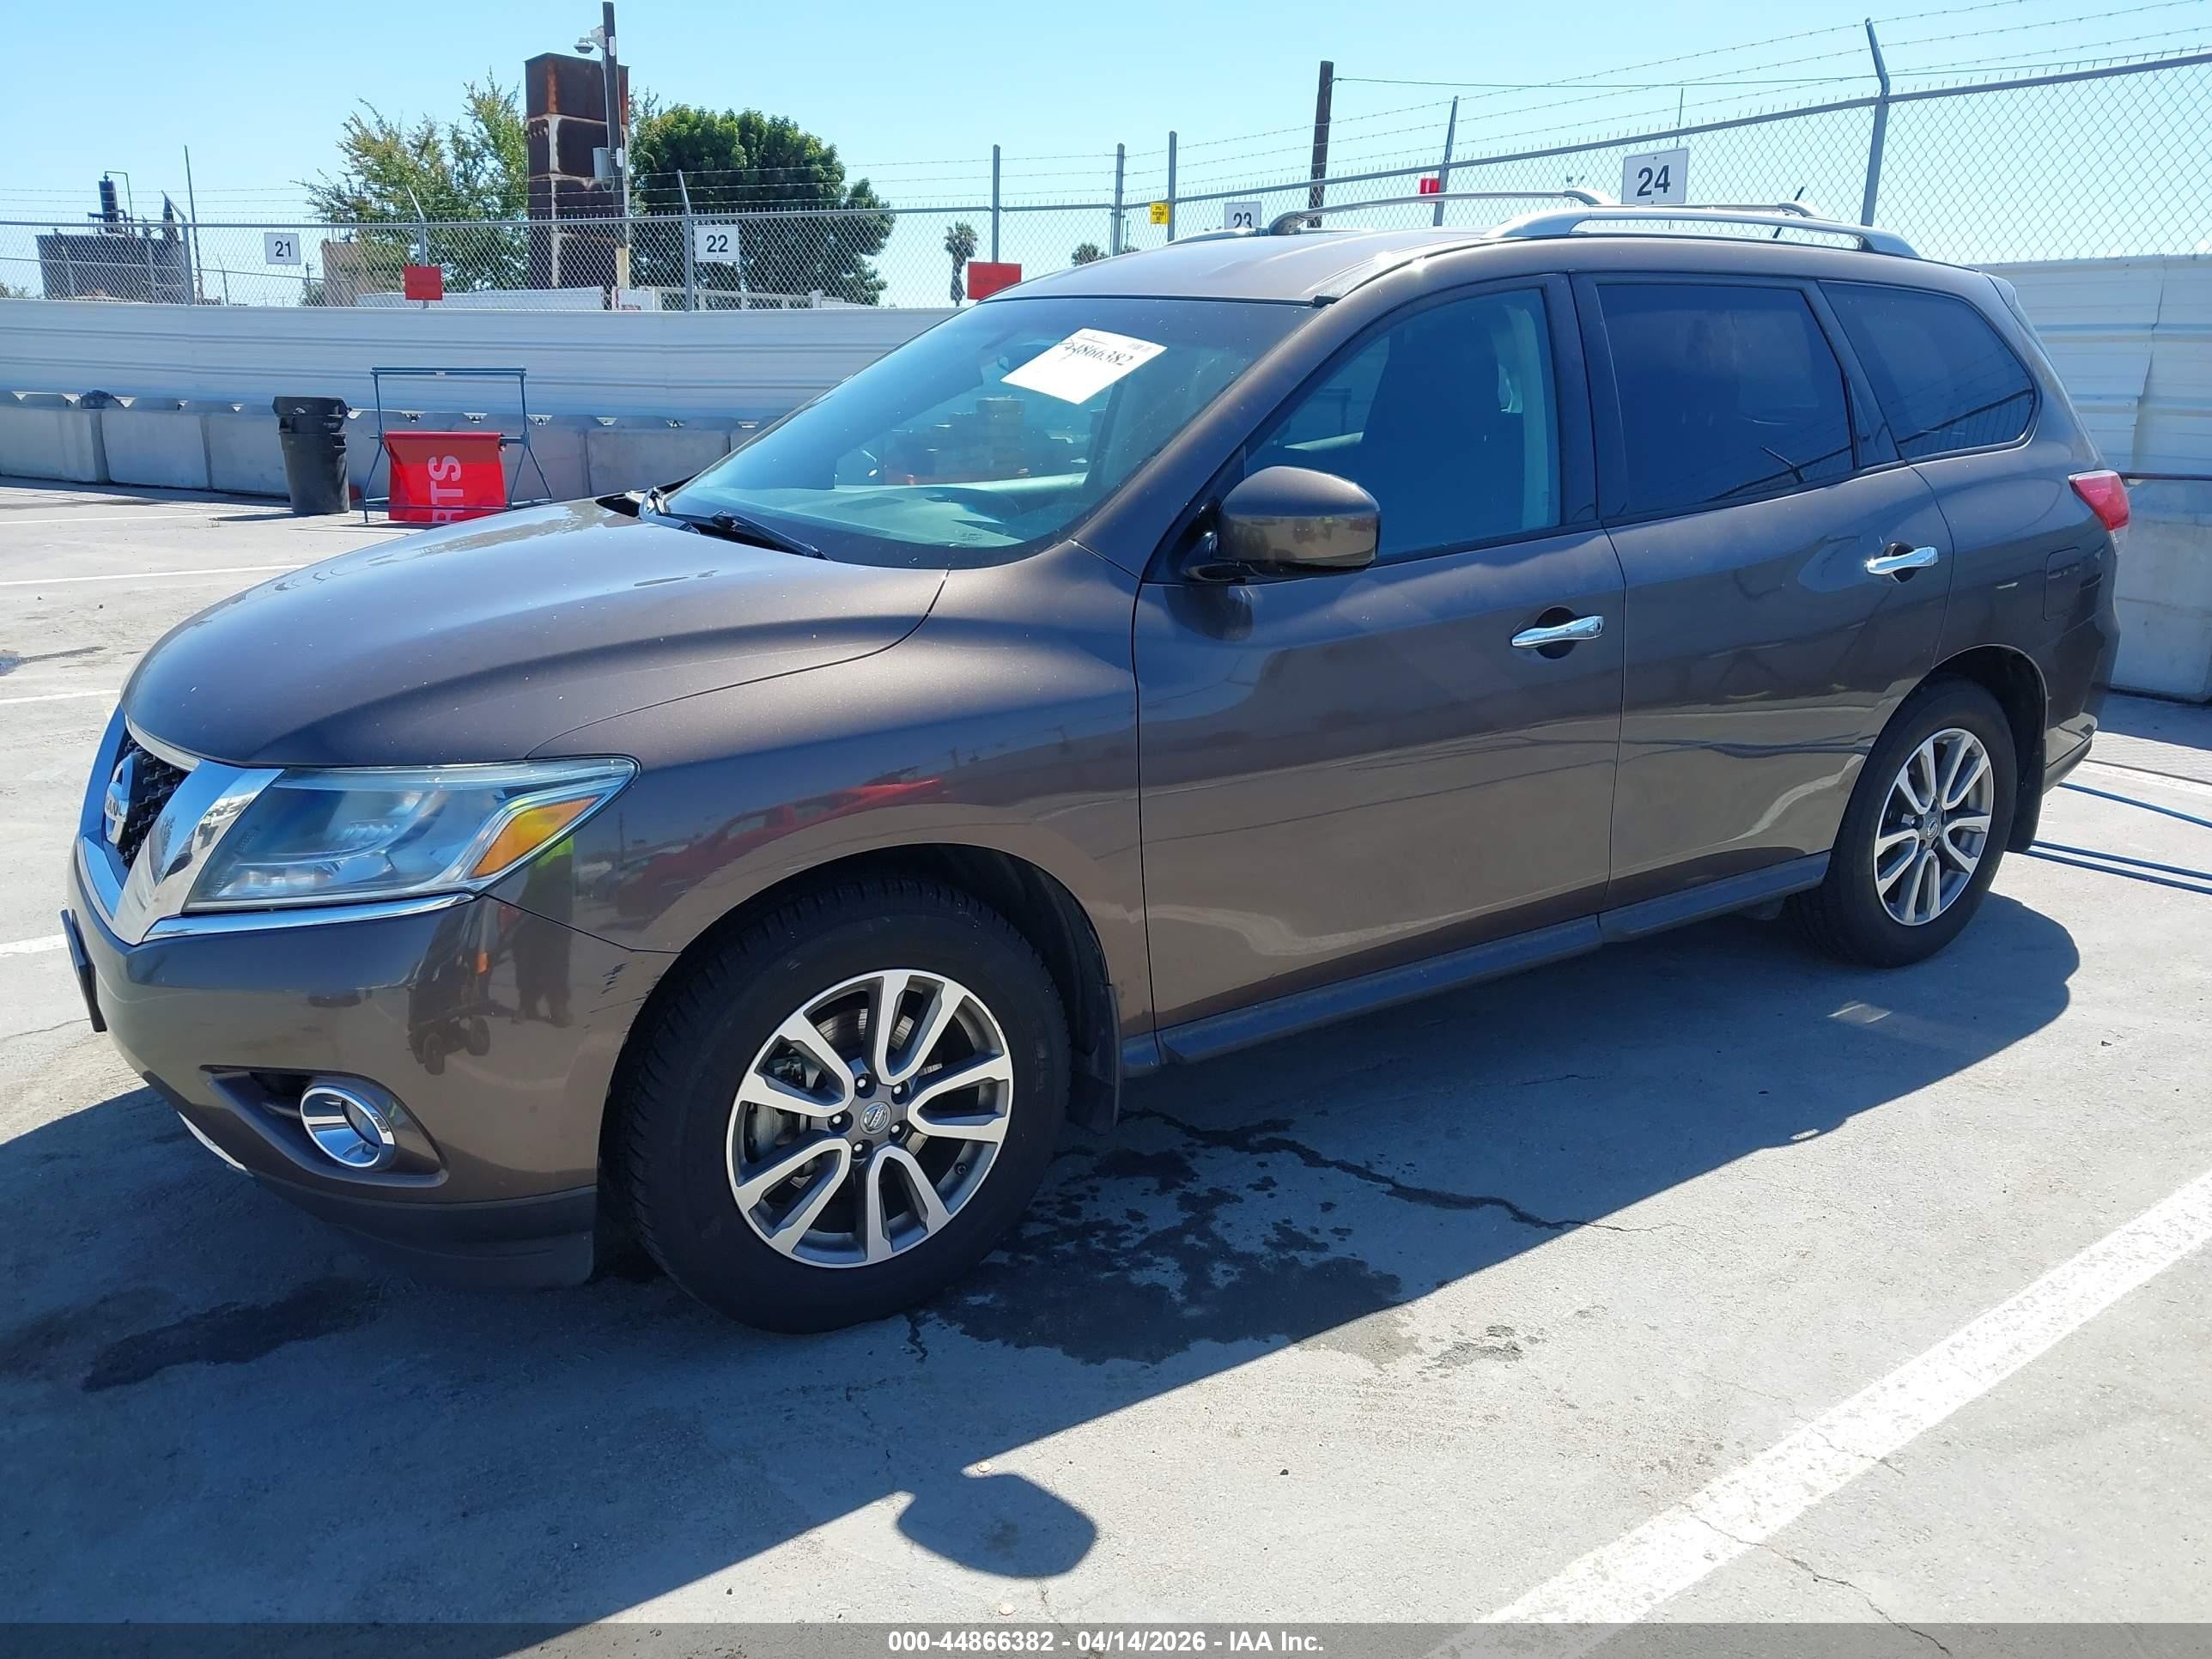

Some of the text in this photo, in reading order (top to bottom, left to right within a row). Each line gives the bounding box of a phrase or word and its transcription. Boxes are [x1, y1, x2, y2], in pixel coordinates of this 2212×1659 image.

[1637, 164, 1671, 198] 24
[1233, 211, 1253, 229] 23
[275, 240, 292, 258] 21
[706, 234, 729, 253] 22
